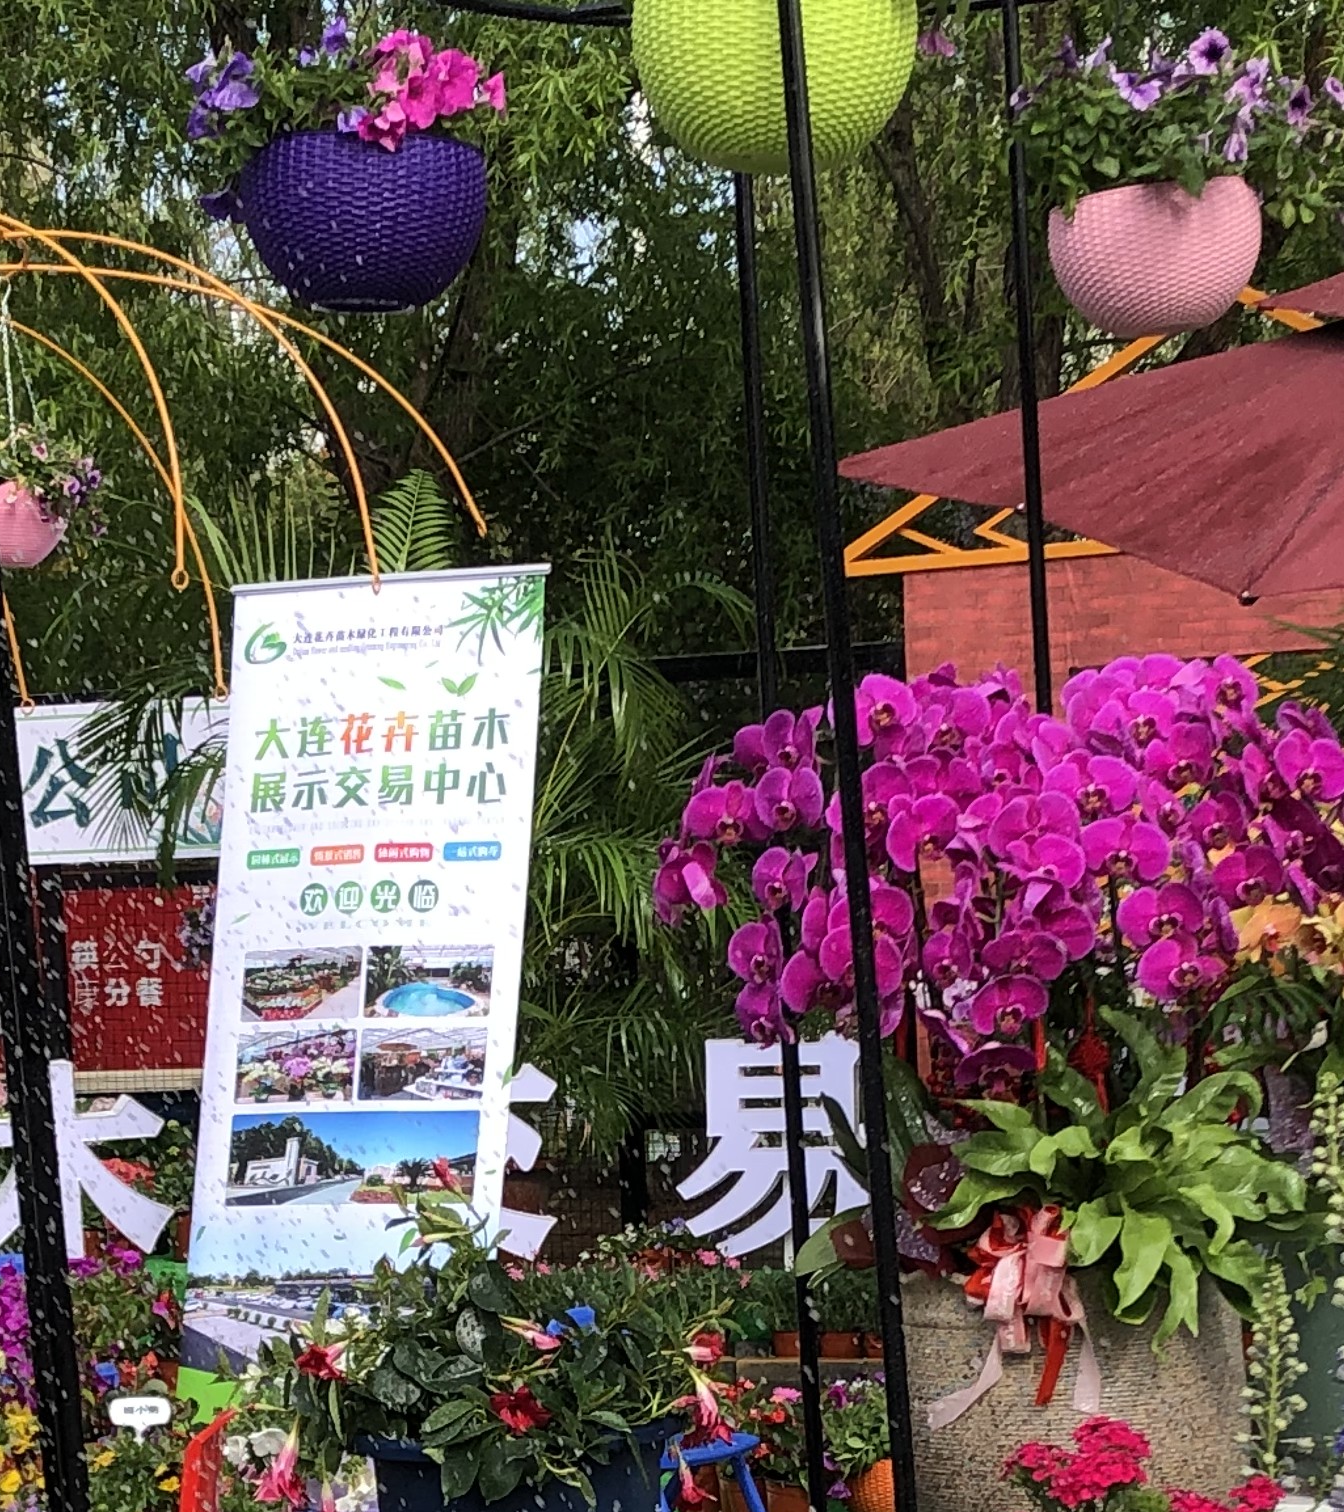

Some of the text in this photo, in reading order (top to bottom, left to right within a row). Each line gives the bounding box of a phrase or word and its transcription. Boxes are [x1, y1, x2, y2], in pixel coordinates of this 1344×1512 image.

[254, 707, 511, 761] 大连花卉苗木
[249, 762, 508, 814] 展示交易中心
[303, 883, 438, 913] 欢迎光临
